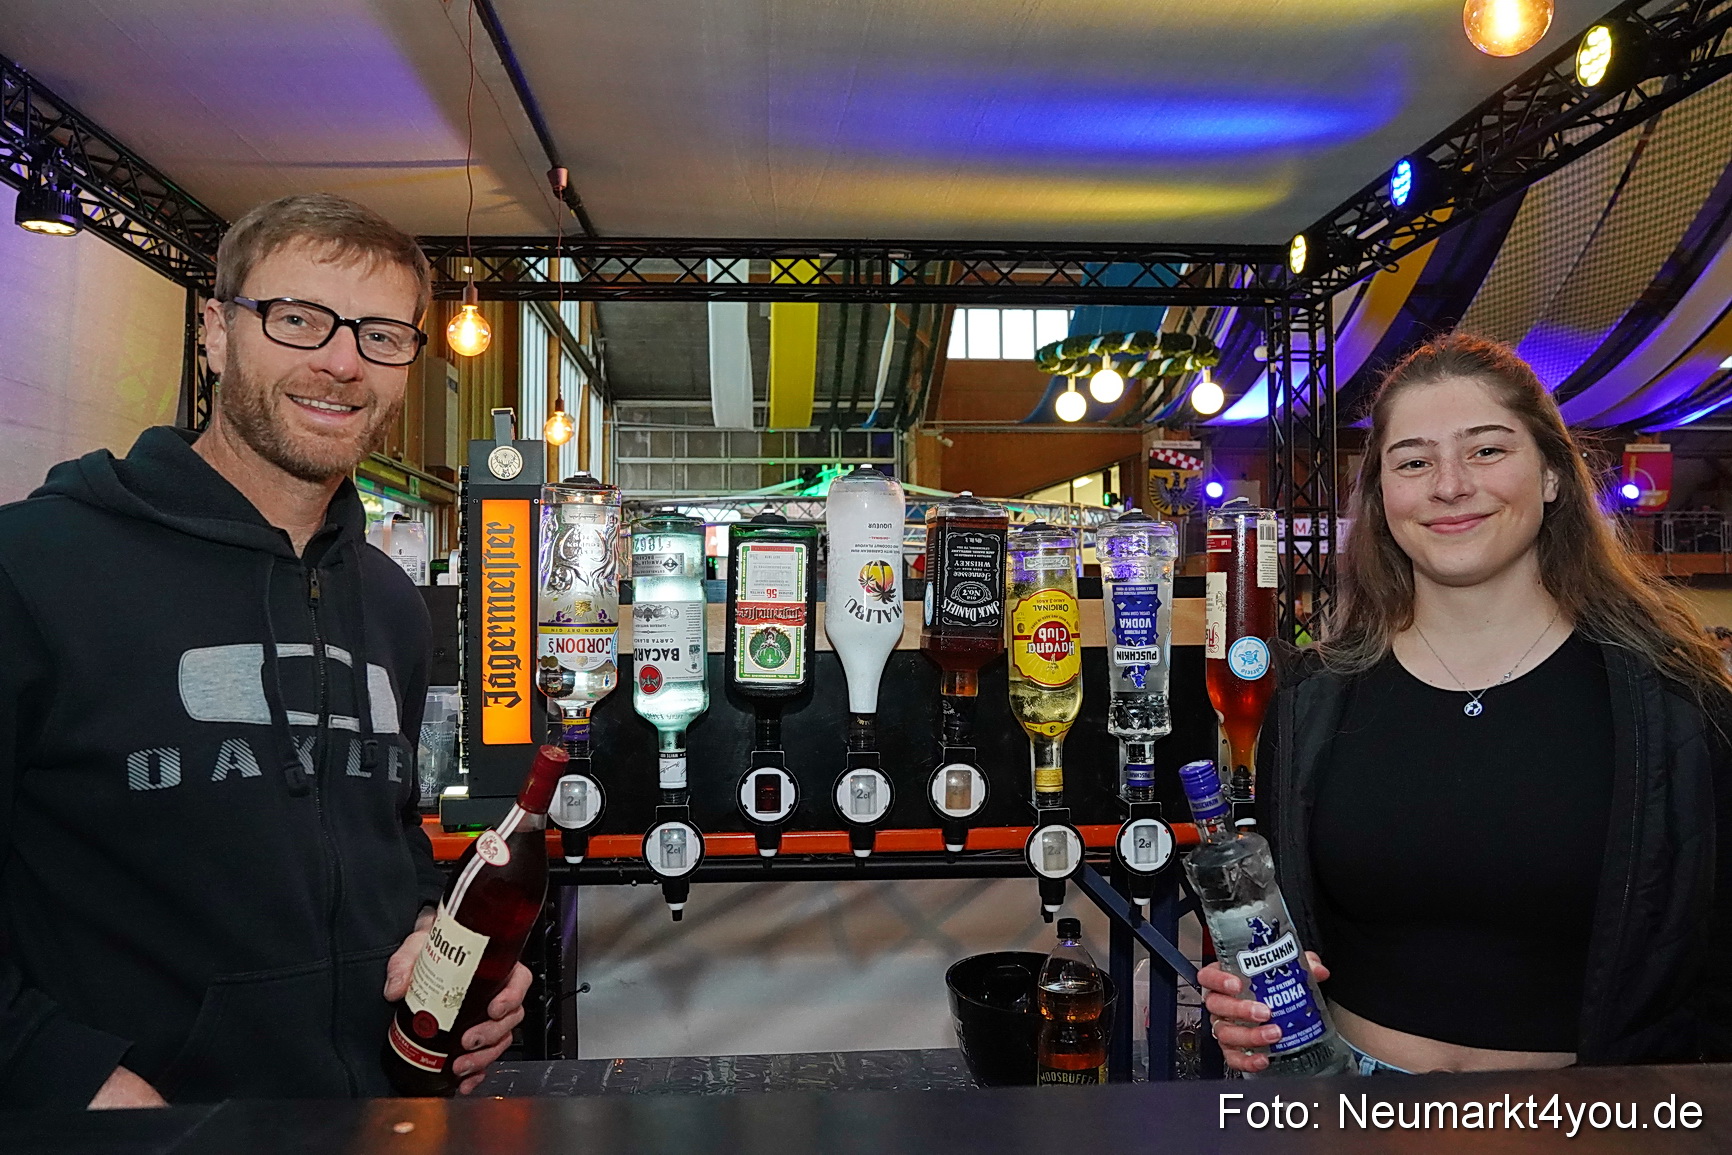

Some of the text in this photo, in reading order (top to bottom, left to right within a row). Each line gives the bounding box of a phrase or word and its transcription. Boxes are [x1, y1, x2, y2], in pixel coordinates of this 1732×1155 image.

[954, 560, 991, 568] WHISKEY
[952, 571, 992, 582] Tennessee
[766, 588, 778, 599] 56
[483, 521, 522, 708] Jägermeister
[844, 597, 903, 625] MALIBU
[940, 598, 977, 622] DANIEL'S
[977, 600, 1000, 619] JACK
[1032, 603, 1069, 613] ORIGINAL
[1118, 617, 1153, 629] VODKA
[1038, 627, 1068, 642] Club
[547, 637, 612, 655] GORDON'S
[1027, 641, 1076, 656] Havana
[633, 647, 680, 662] BACARD
[1116, 650, 1158, 661] PUSCHKIN
[1049, 725, 1057, 734] 3
[856, 787, 870, 799] 2cl
[1138, 838, 1152, 849] 2cl
[429, 926, 467, 968] sbach
[1242, 940, 1296, 970] PUSCHKIN
[1263, 982, 1307, 1009] VODKA
